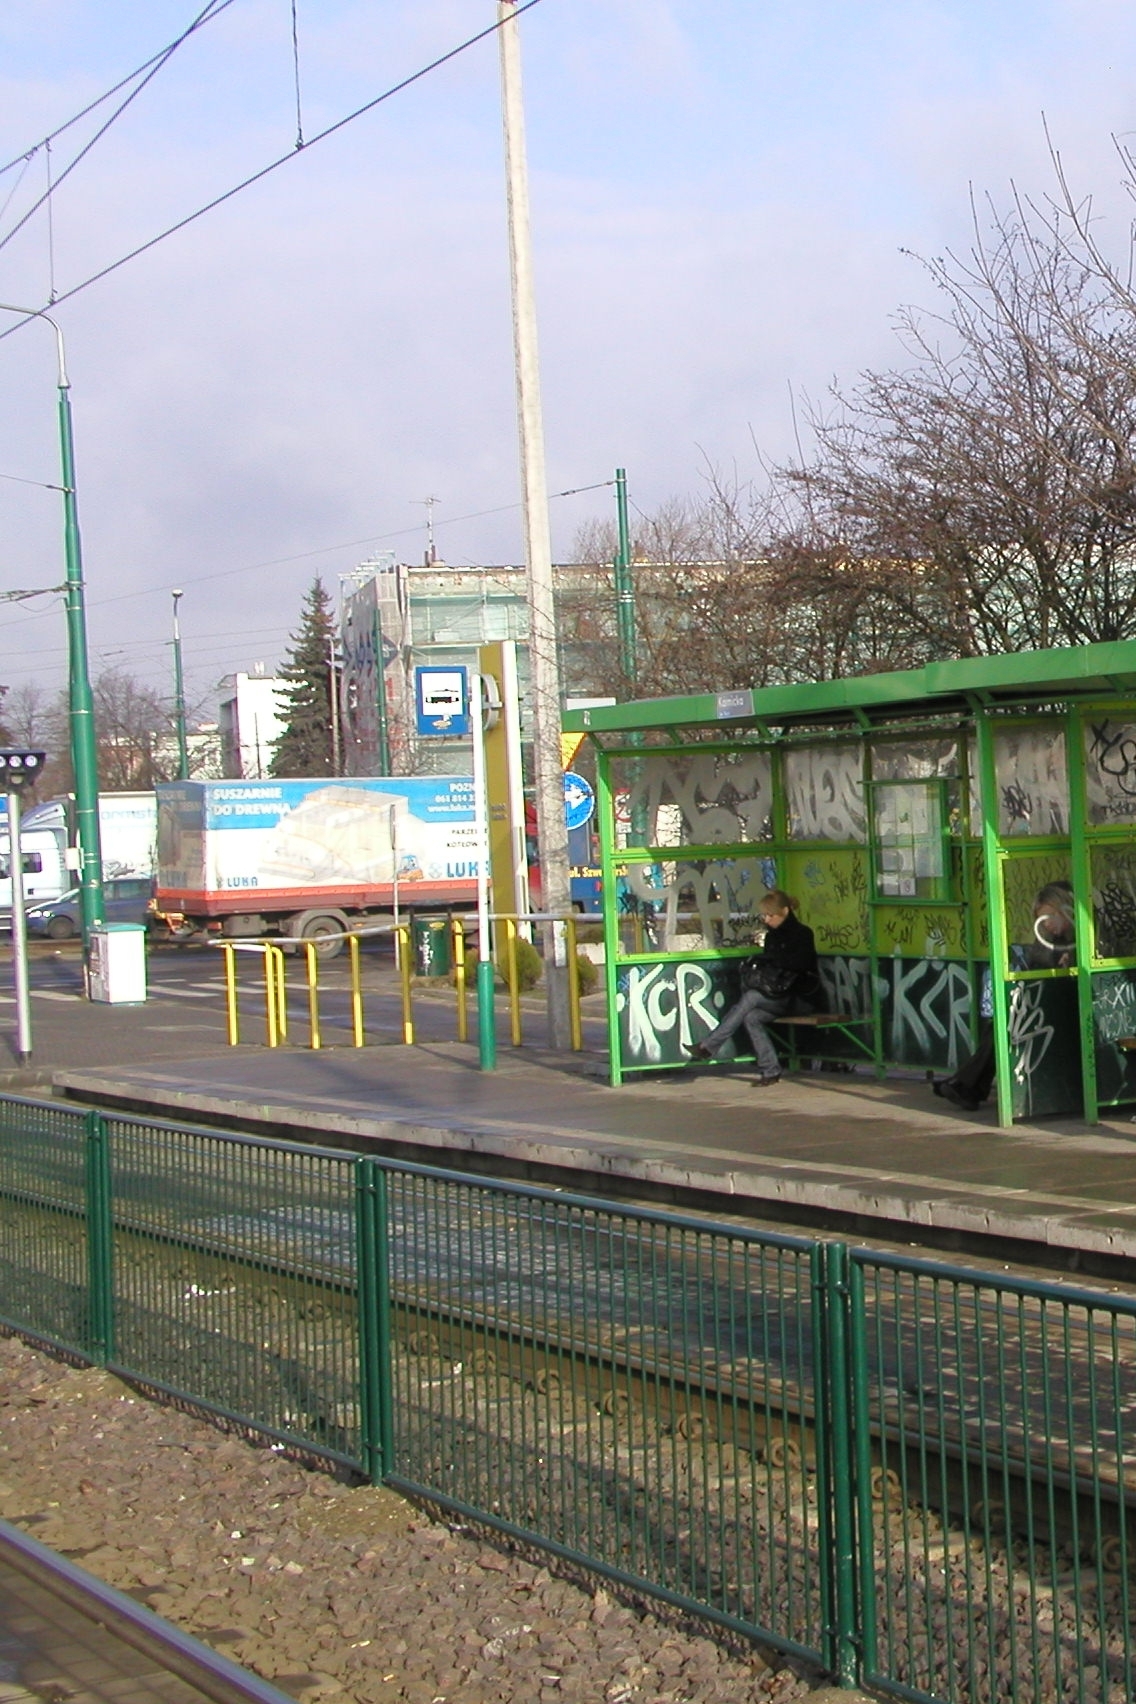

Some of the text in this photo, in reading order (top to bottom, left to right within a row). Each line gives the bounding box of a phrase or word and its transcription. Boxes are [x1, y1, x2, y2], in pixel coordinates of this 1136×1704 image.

[212, 787, 282, 800] SUSZARNIE
[213, 804, 231, 816] DO
[237, 803, 291, 816] DREWNA
[227, 877, 258, 887] LUKA
